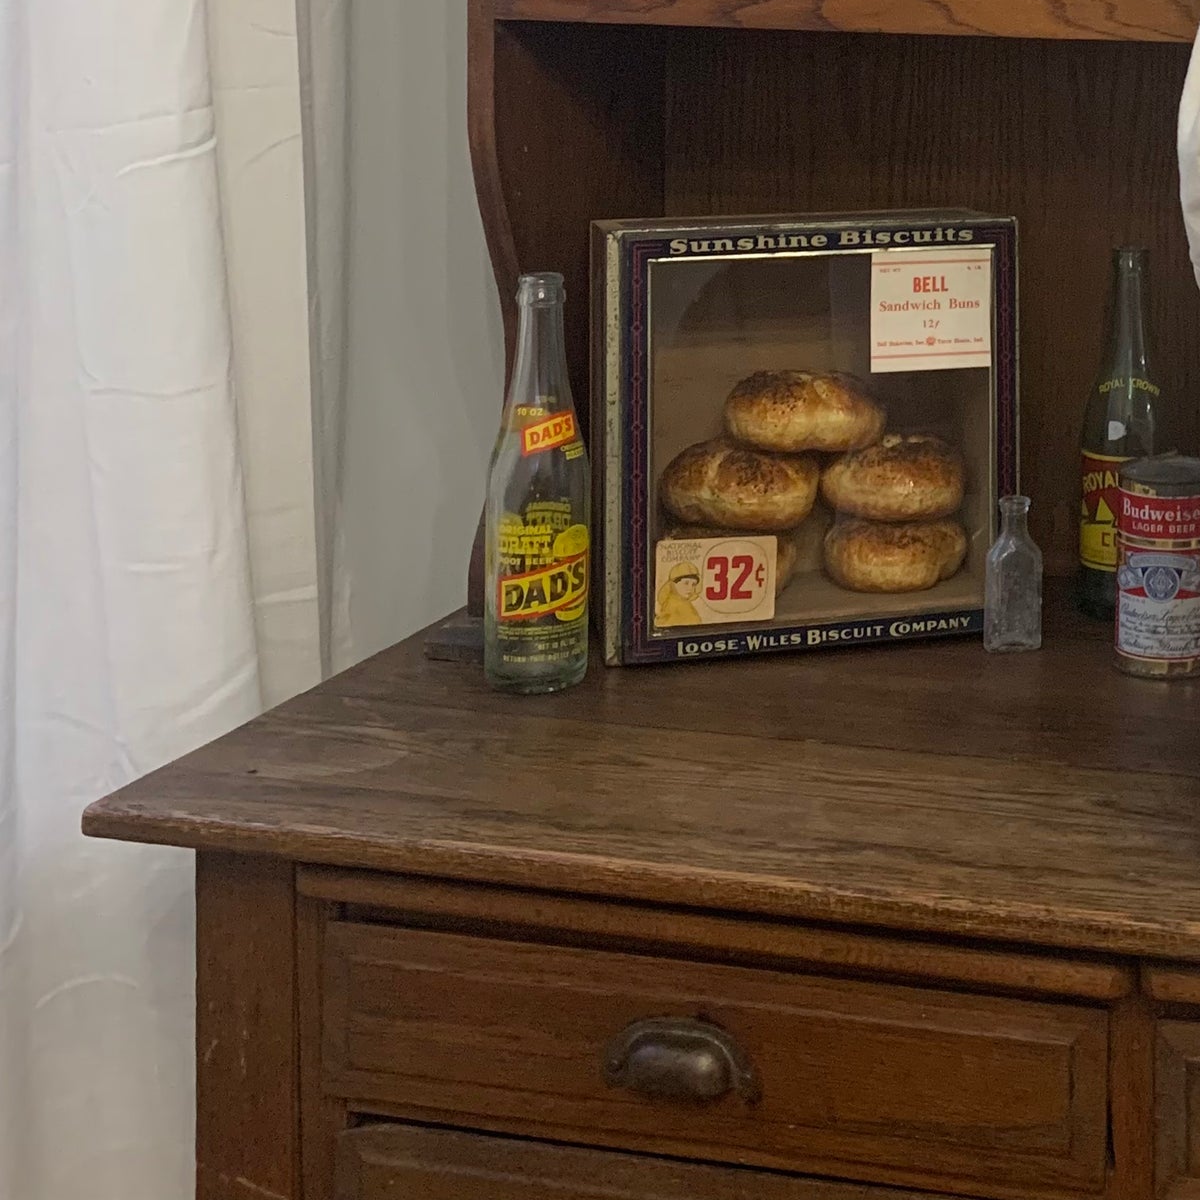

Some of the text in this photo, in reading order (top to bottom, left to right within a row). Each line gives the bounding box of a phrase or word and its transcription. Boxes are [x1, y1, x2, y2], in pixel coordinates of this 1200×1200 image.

[669, 228, 974, 254] Sunshine Biscuits
[912, 276, 949, 293] BELL
[878, 298, 980, 312] Sandwich Buns
[1098, 378, 1125, 393] ROYAL
[529, 416, 573, 446] DAD'S
[1132, 522, 1196, 534] LAGER BEER
[498, 535, 551, 554] DRAFT
[503, 560, 586, 613] DAD'S
[677, 616, 972, 657] LOOSE-WILES BISCUIT COMPANY
